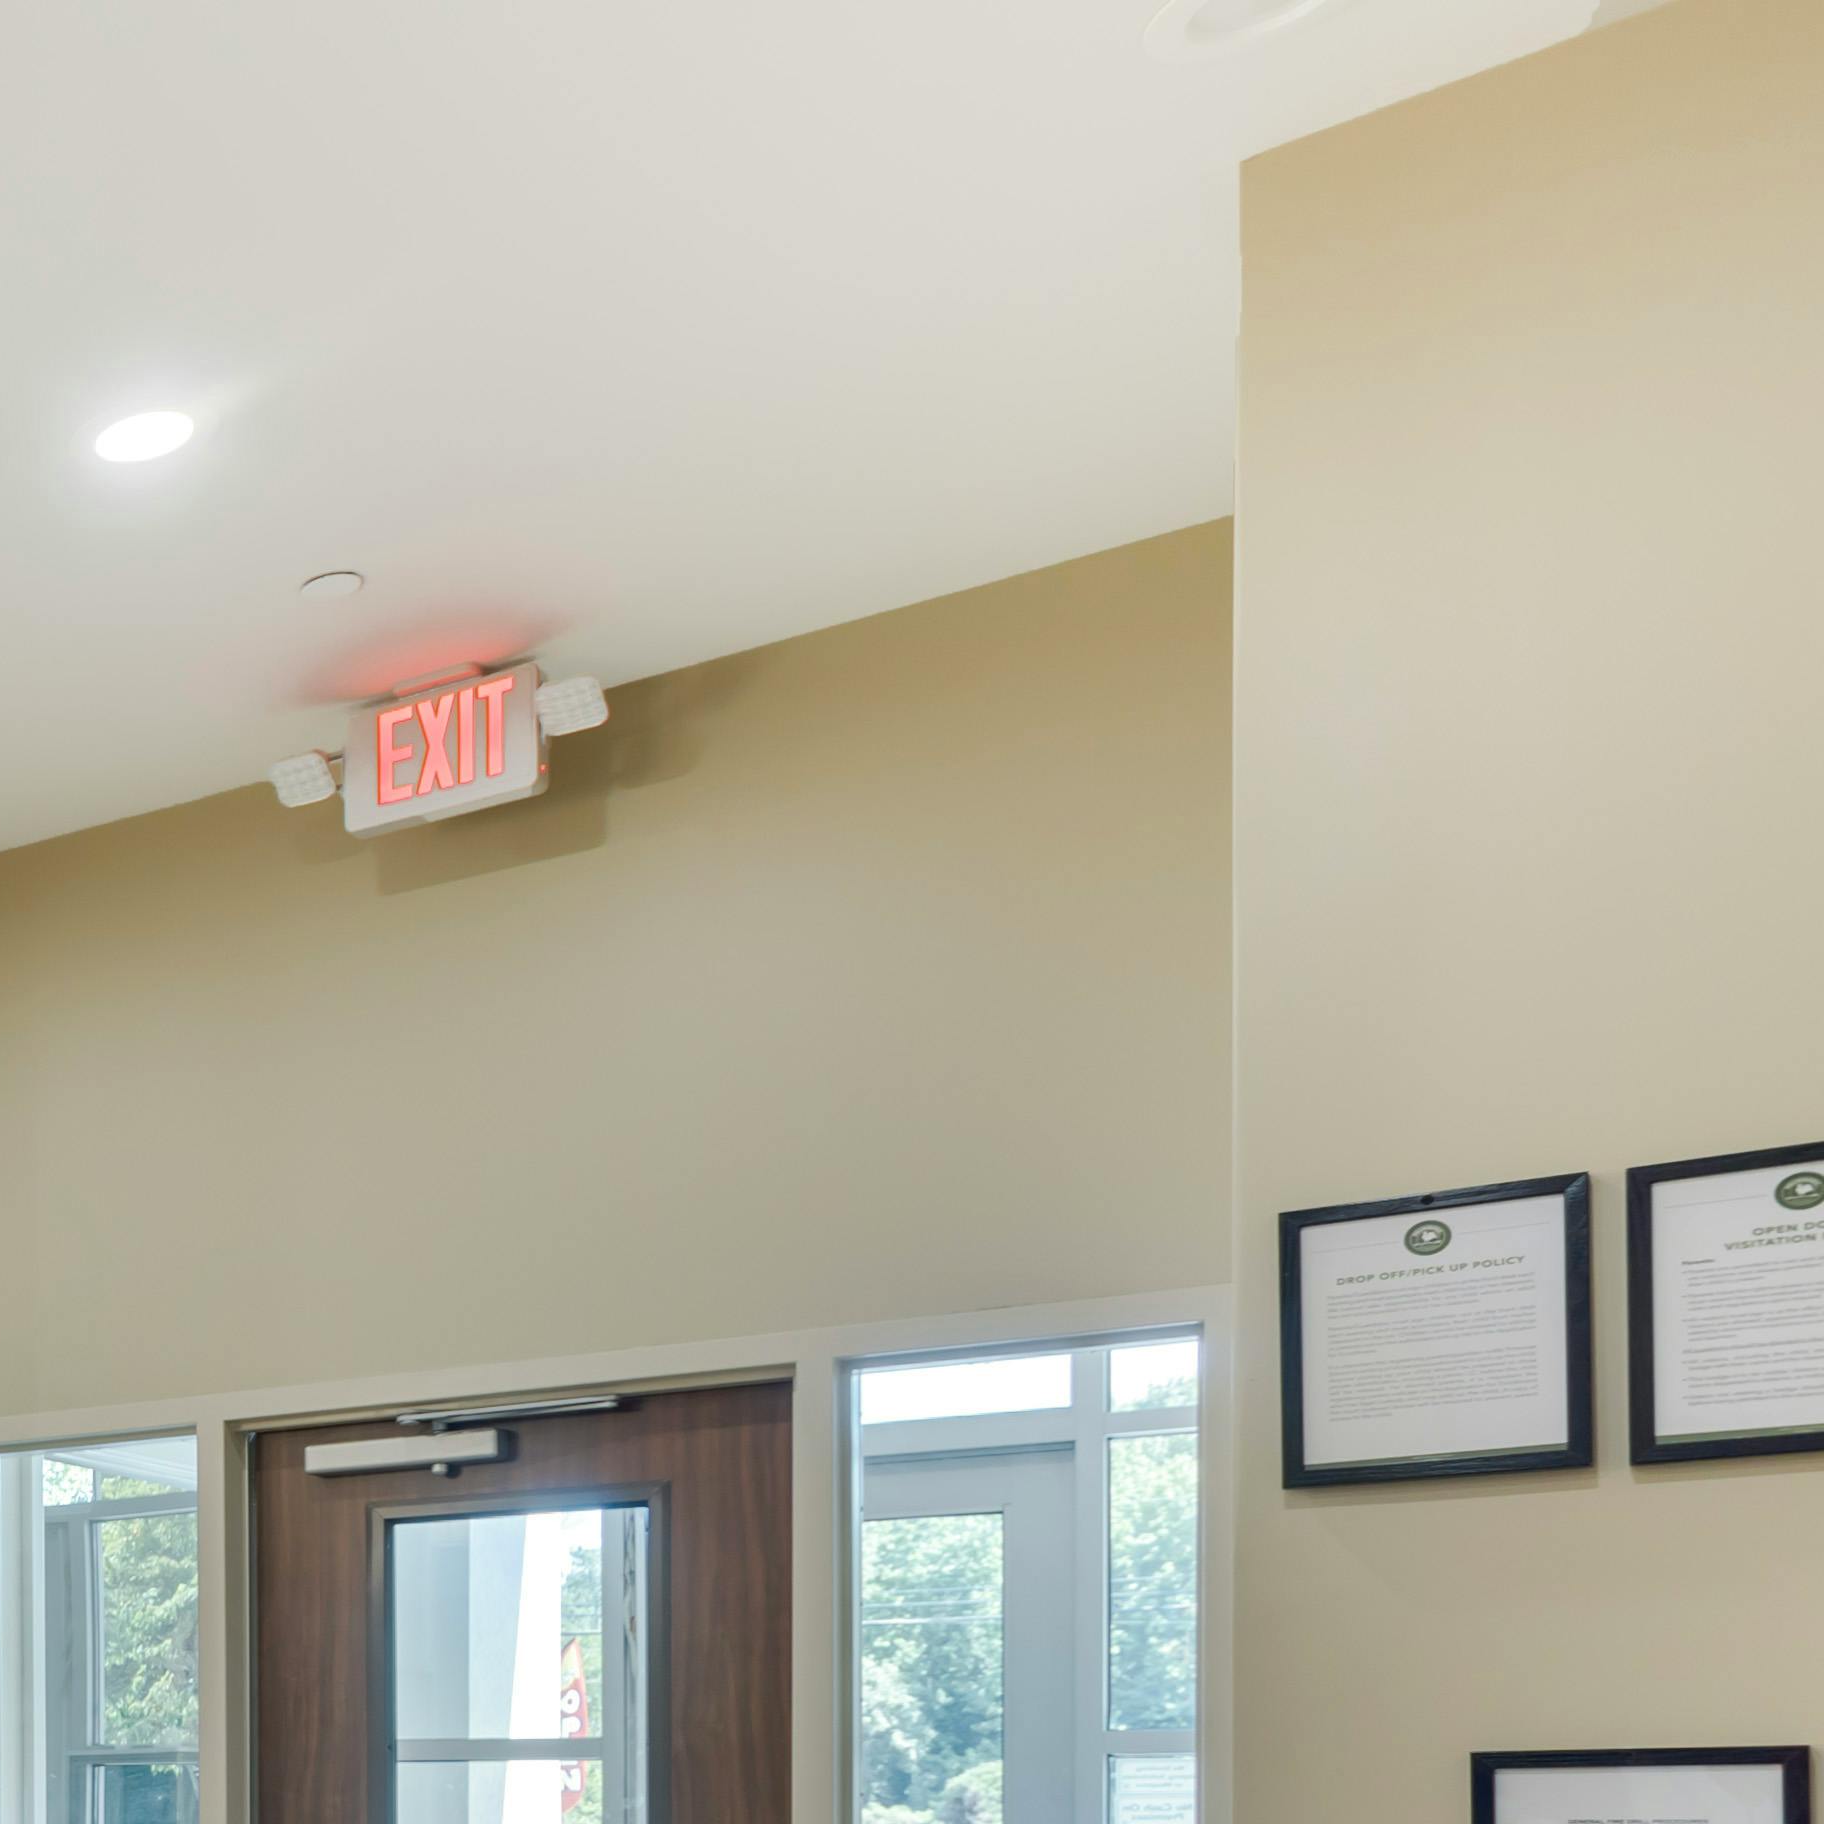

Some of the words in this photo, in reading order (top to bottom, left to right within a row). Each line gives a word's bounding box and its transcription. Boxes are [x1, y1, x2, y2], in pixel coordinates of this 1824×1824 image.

[377, 675, 513, 807] EXIT
[1752, 1223, 1798, 1236] OPEN
[1724, 1233, 1817, 1251] VISITATION
[1336, 1273, 1375, 1286] DROP
[1379, 1265, 1445, 1281] OFF/PICK
[1449, 1263, 1468, 1273] UP
[1472, 1255, 1526, 1270] POLICY
